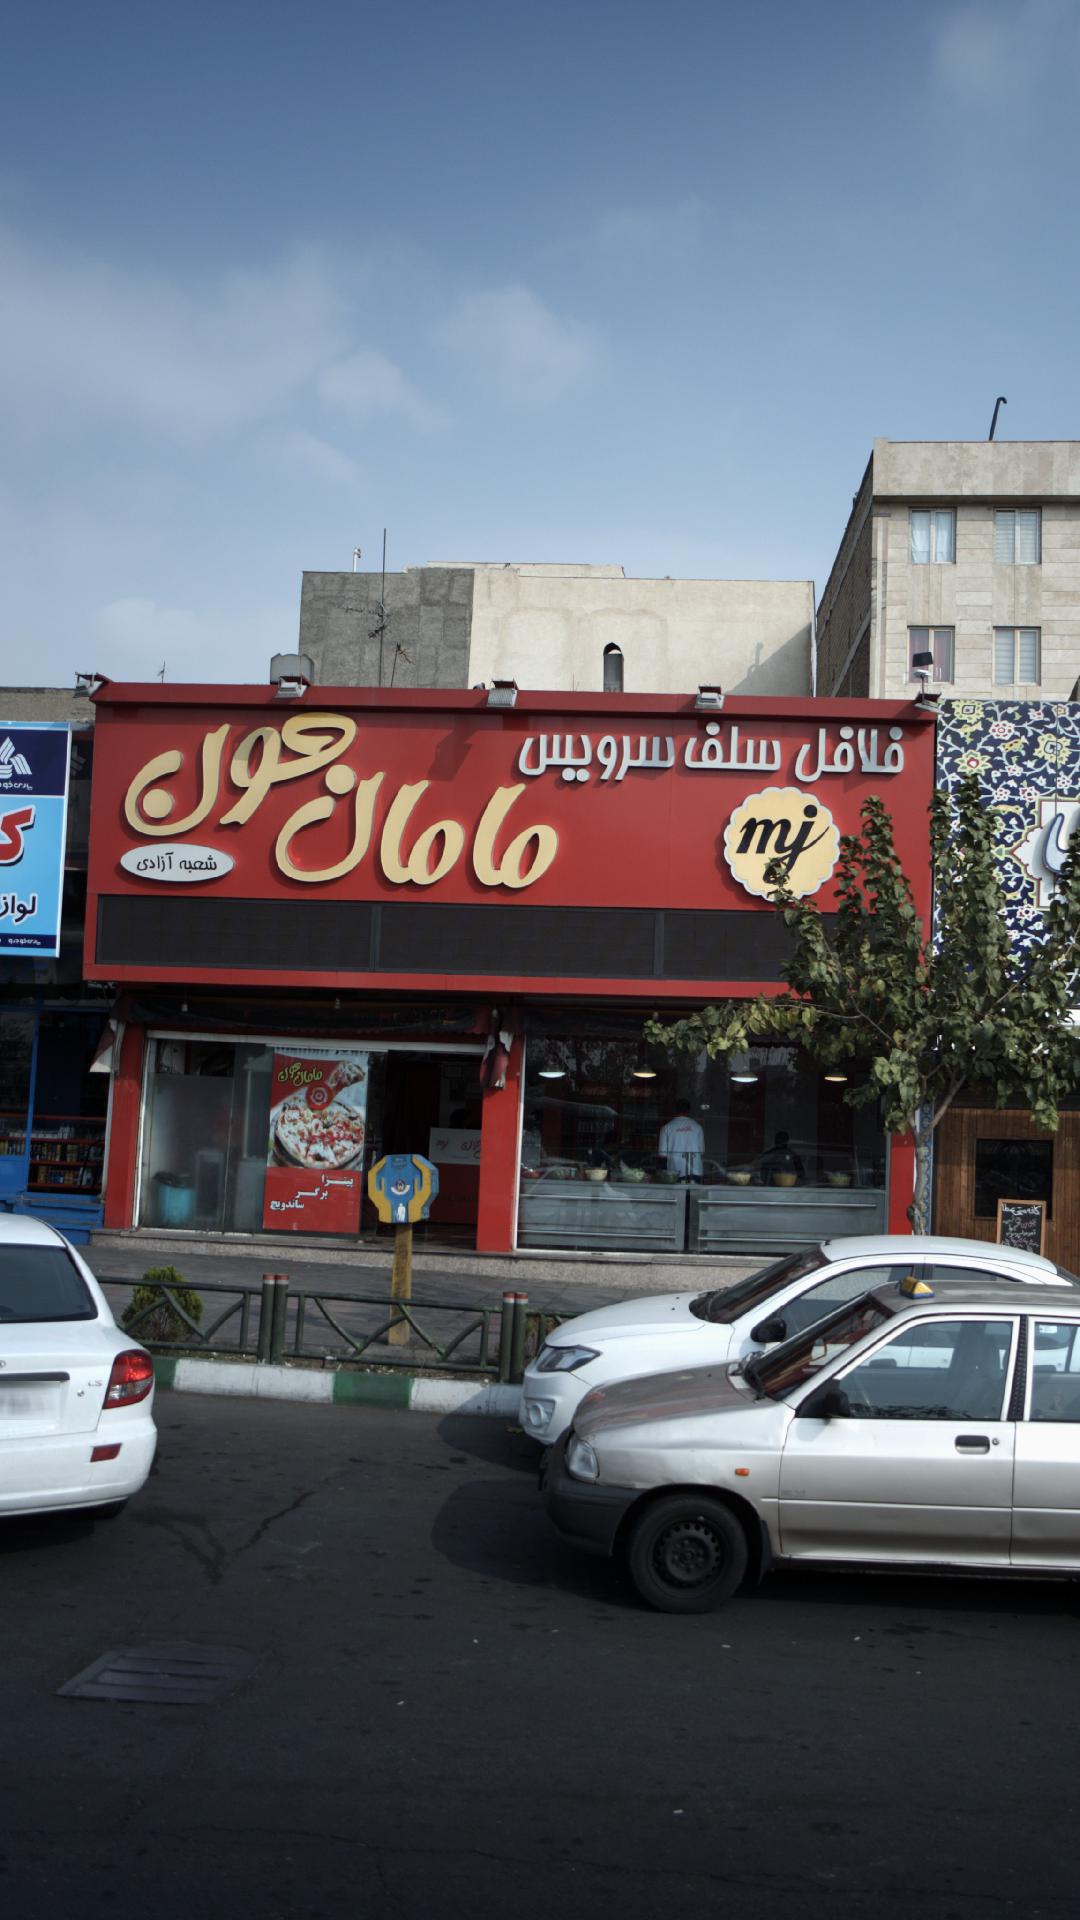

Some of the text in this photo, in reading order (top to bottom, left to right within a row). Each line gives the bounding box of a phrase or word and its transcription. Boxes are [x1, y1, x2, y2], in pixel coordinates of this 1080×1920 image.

[518, 722, 904, 782] فلافل سلف سرویس
[124, 712, 559, 888] مامان جون
[136, 852, 217, 873] شعبه آزادی
[293, 1066, 323, 1087] مامان
[321, 1174, 354, 1188] پیتزا
[270, 1199, 305, 1211] ساندویچ
